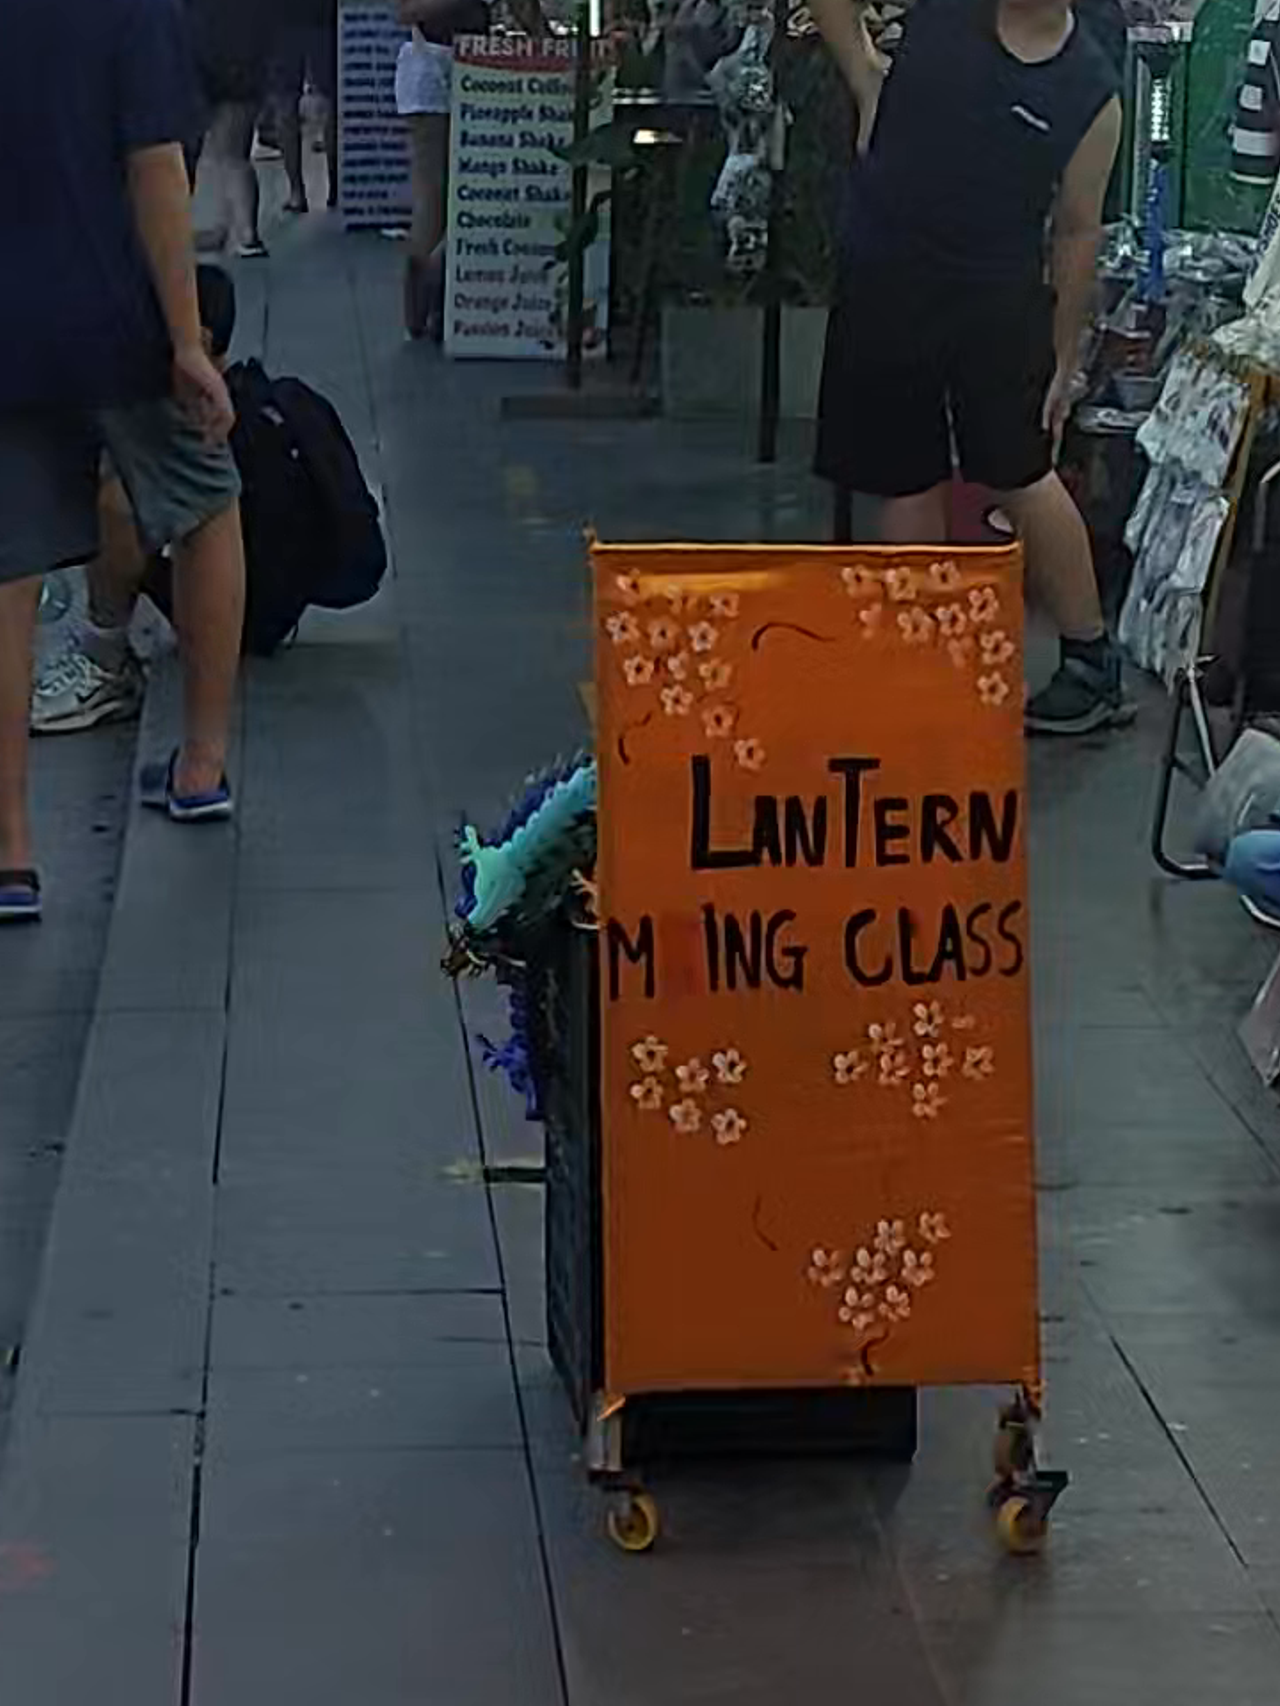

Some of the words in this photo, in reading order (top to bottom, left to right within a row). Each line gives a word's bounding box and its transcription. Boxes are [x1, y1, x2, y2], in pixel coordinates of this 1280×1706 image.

[458, 37, 533, 58] FRESH
[461, 103, 534, 124] Pineapple
[458, 158, 507, 177] Mango
[458, 186, 519, 202] Coconut
[457, 210, 531, 229] Chocolate
[844, 899, 1024, 987] CLASS
